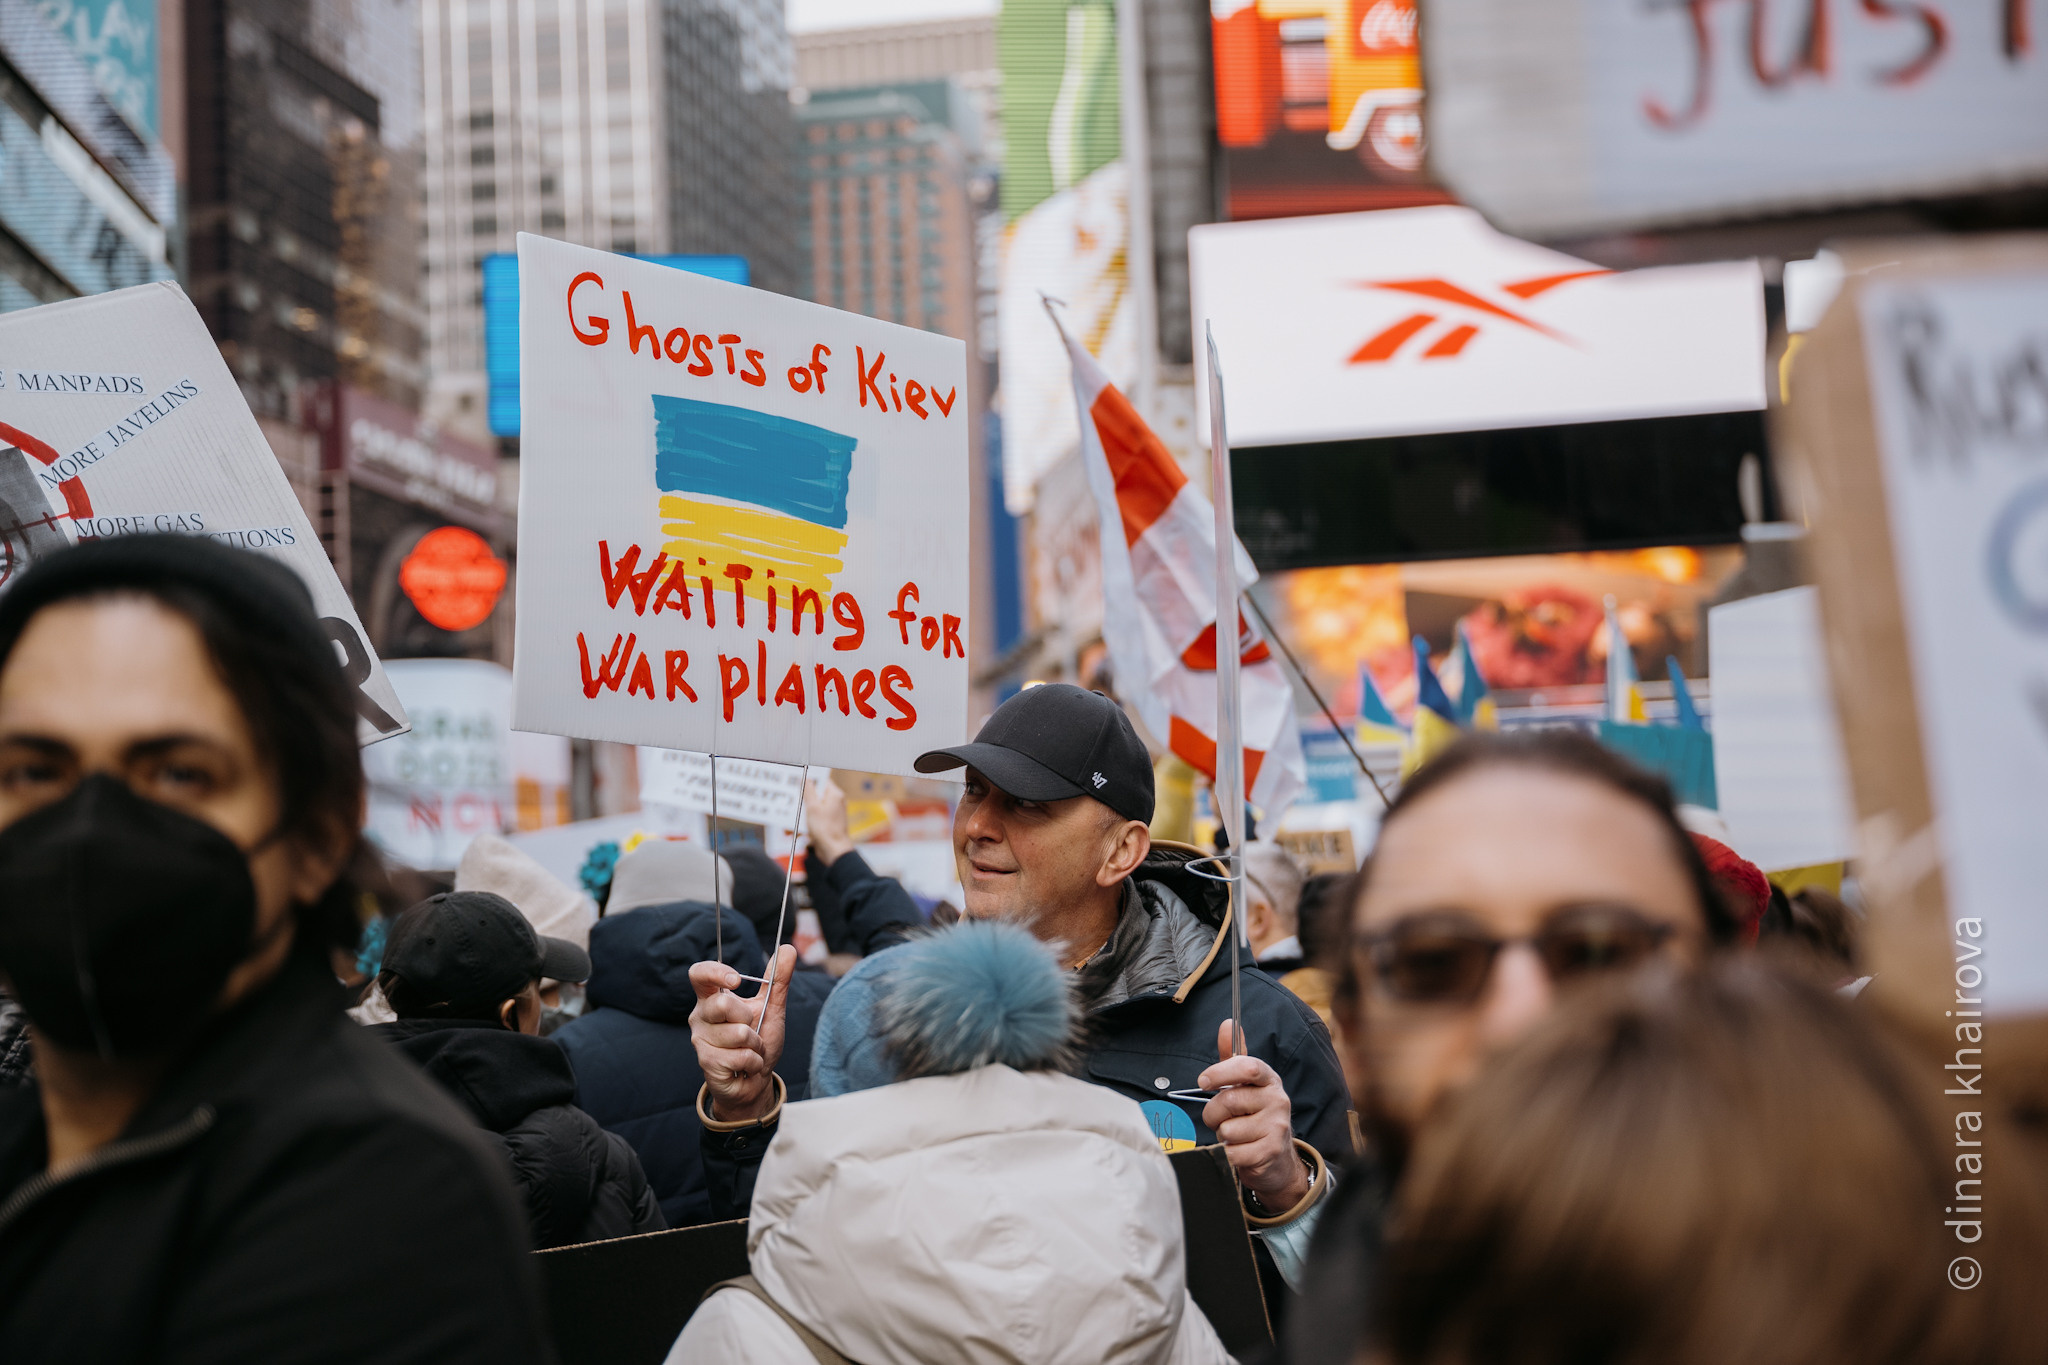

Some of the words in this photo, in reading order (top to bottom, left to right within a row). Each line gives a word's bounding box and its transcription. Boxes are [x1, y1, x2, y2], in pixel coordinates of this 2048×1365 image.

[18, 373, 145, 394] MANPADS
[787, 343, 832, 395] of
[855, 345, 956, 421] Kiev
[39, 442, 105, 489] MORE
[106, 379, 198, 447] JAVELINS
[74, 515, 146, 538] MORE
[154, 513, 204, 534] GAS
